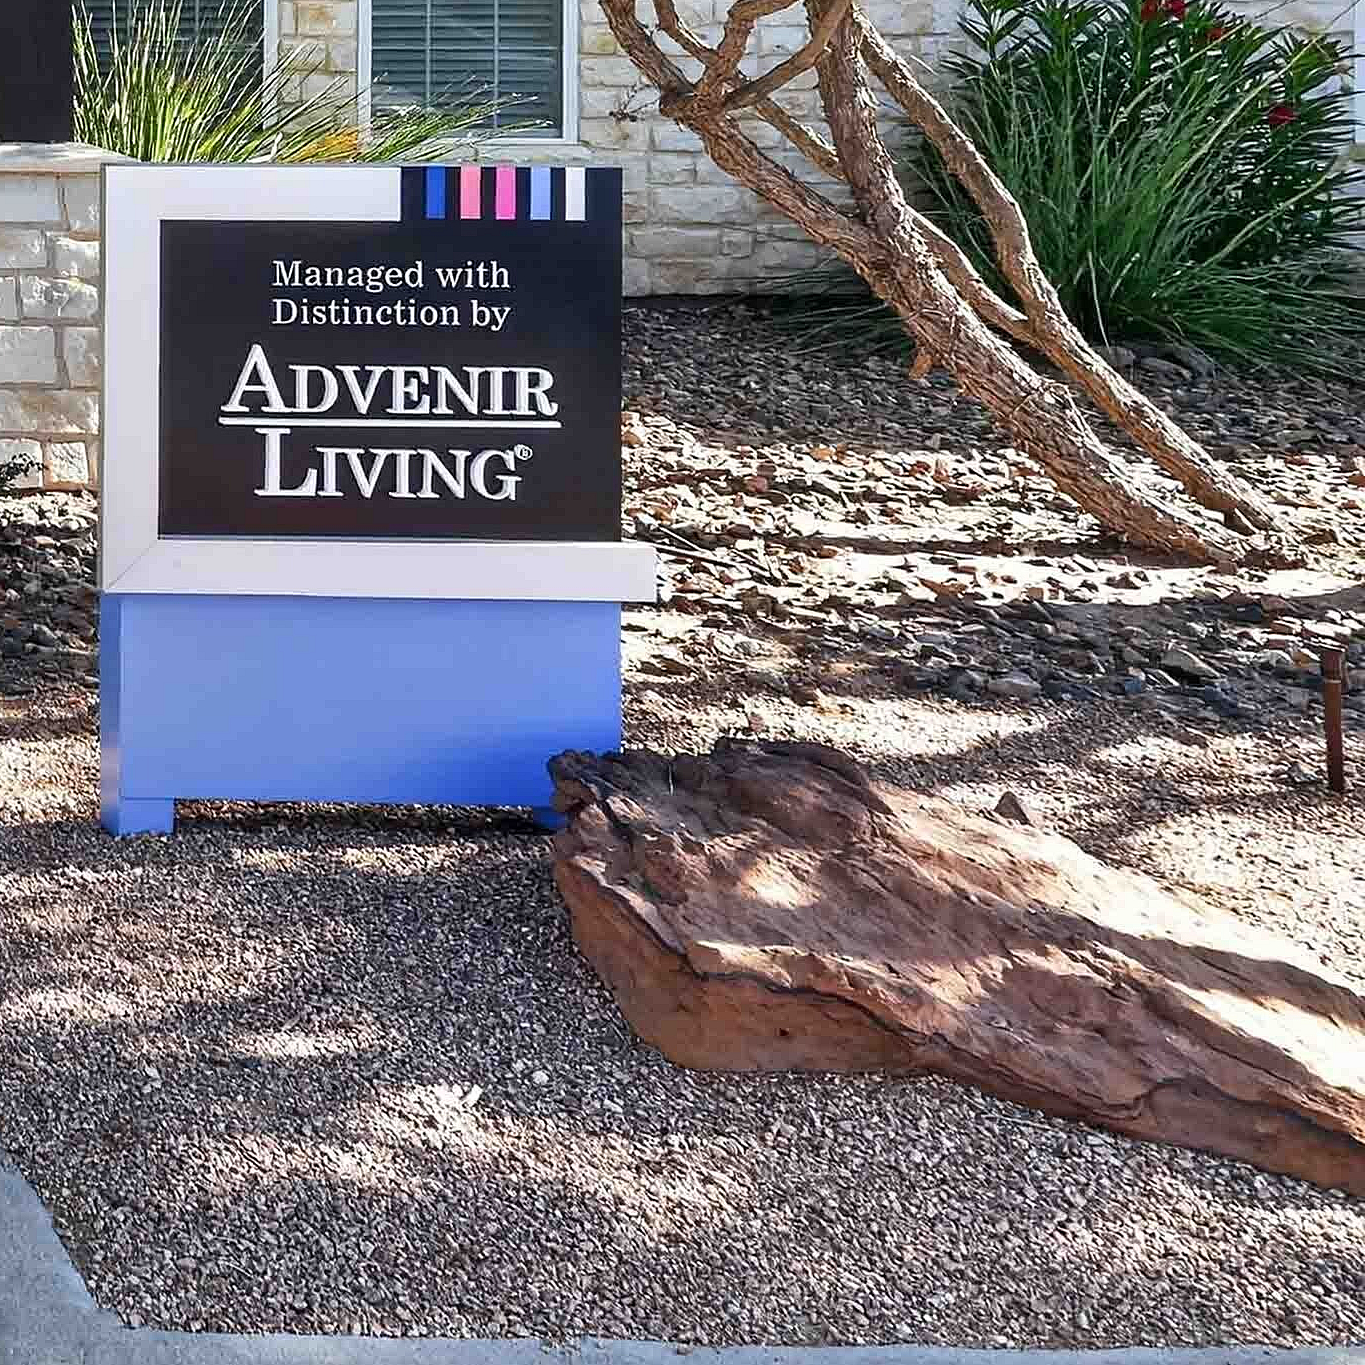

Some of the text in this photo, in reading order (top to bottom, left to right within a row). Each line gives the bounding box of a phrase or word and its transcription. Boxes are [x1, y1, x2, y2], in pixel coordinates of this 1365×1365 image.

[272, 260, 510, 293] Managed with
[271, 297, 512, 332] Distinction by
[219, 343, 559, 417] ADVENIR
